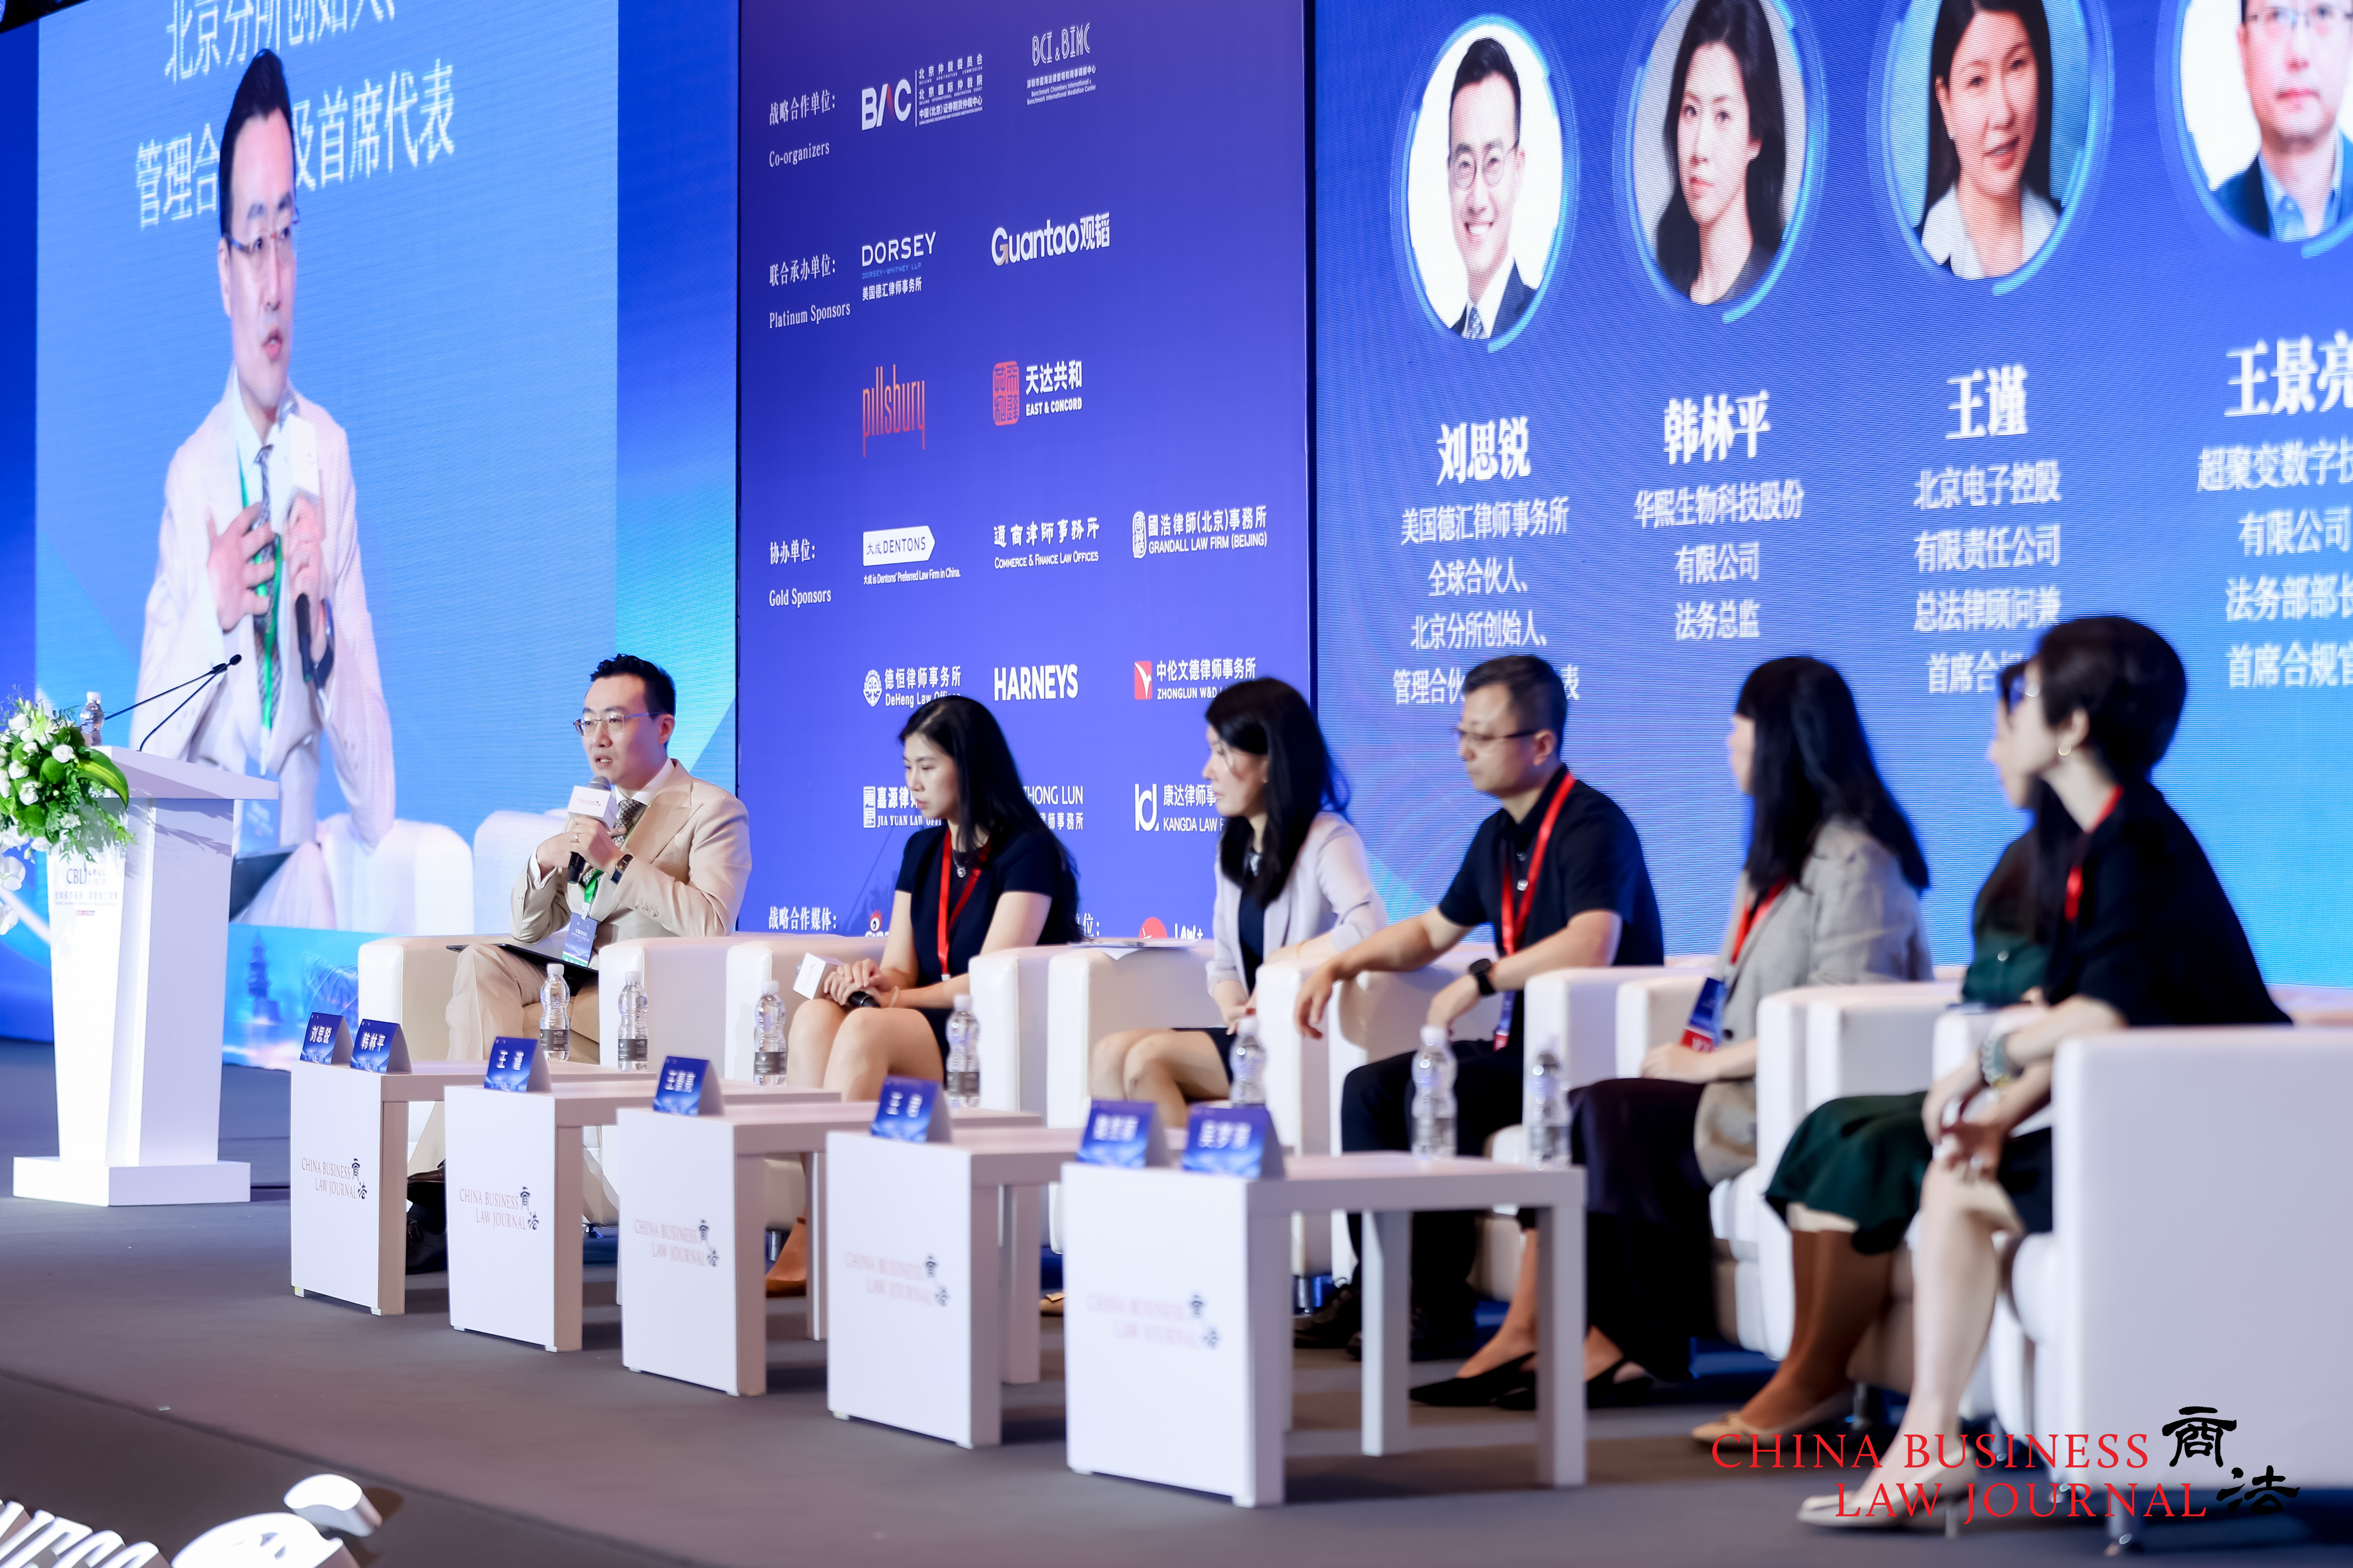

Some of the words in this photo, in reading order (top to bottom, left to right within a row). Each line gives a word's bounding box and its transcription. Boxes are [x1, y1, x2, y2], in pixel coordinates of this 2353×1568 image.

[1032, 32, 1052, 66] BCI
[1055, 47, 1060, 61] &
[1061, 22, 1090, 60] BIMC
[919, 54, 983, 80] 北京仲裁委员会
[919, 74, 983, 100] 北京国际仲裁院
[1027, 95, 1045, 105] Benchmark
[1046, 90, 1067, 101] International
[1067, 86, 1084, 96] Mediation
[1031, 87, 1050, 97] Benchmark
[1050, 84, 1067, 93] Chambers
[1067, 78, 1089, 89] International
[769, 142, 830, 168] Co-organizers
[862, 231, 936, 267] DORSEY
[862, 277, 922, 302] 美国德汇律师事务所
[769, 310, 807, 329] Platinum
[811, 303, 851, 324] Sponsors
[1026, 360, 1083, 396] 天达共和
[862, 364, 926, 458] pillsbury
[1026, 402, 1043, 417] EAST
[1044, 401, 1050, 414] &
[1051, 397, 1083, 413] CONCORD
[1664, 389, 1771, 464] 韩林平
[1436, 416, 1531, 486] 刘思锐
[1913, 459, 2061, 511] 北京电子控股
[1633, 479, 1805, 529] 华熙生物科技股份
[1401, 496, 1570, 545] 美国德汇律师事务所
[2238, 507, 2351, 557] 有限公司
[1149, 539, 1189, 554] GRANDALL
[1191, 537, 1208, 551] LAW
[1210, 536, 1229, 550] FIRM
[1231, 531, 1267, 550] (BEIJING)
[1913, 524, 2061, 574] 有限责任公司
[1028, 554, 1034, 567] &
[1674, 541, 1760, 584] 有限公司
[897, 570, 919, 582] Preferred
[919, 570, 929, 580] Law
[929, 569, 939, 580] Firm
[940, 568, 945, 579] in
[945, 567, 961, 578] China.
[1427, 556, 1528, 596] 全球合伙人、
[769, 589, 789, 607] Gold
[791, 588, 831, 608] Sponsors
[1913, 586, 2062, 632] 总法律顾问兼
[1410, 609, 1547, 651] 北京分所创始人、
[1675, 599, 1761, 641] 法务总监
[885, 666, 961, 690] 德恒律师事务所
[994, 663, 1079, 701] HARNEYS
[1157, 657, 1256, 682] 中伦文德律师事务所
[885, 693, 914, 709] DeHeng
[917, 692, 932, 706] Law
[1157, 687, 1198, 700] ZHONGLUN
[1200, 686, 1217, 699] W&D
[1062, 785, 1083, 805] LUN
[877, 815, 888, 828] JIA
[890, 815, 908, 826] YUAN
[910, 815, 923, 826] LAW
[1163, 817, 1198, 832] KANGDA
[1199, 818, 1218, 832] LAW
[310, 1025, 332, 1044] 刘思锐
[361, 1032, 386, 1052] 韩林平
[302, 1158, 321, 1174] CHINA
[323, 1162, 350, 1180] BUSINESS
[316, 1178, 328, 1192] LAW
[329, 1181, 357, 1199] JOURNAL
[460, 1188, 483, 1205] CHINA
[485, 1192, 519, 1210] BUSINESS
[476, 1209, 491, 1224] LAW
[493, 1212, 527, 1230] JOURNAL
